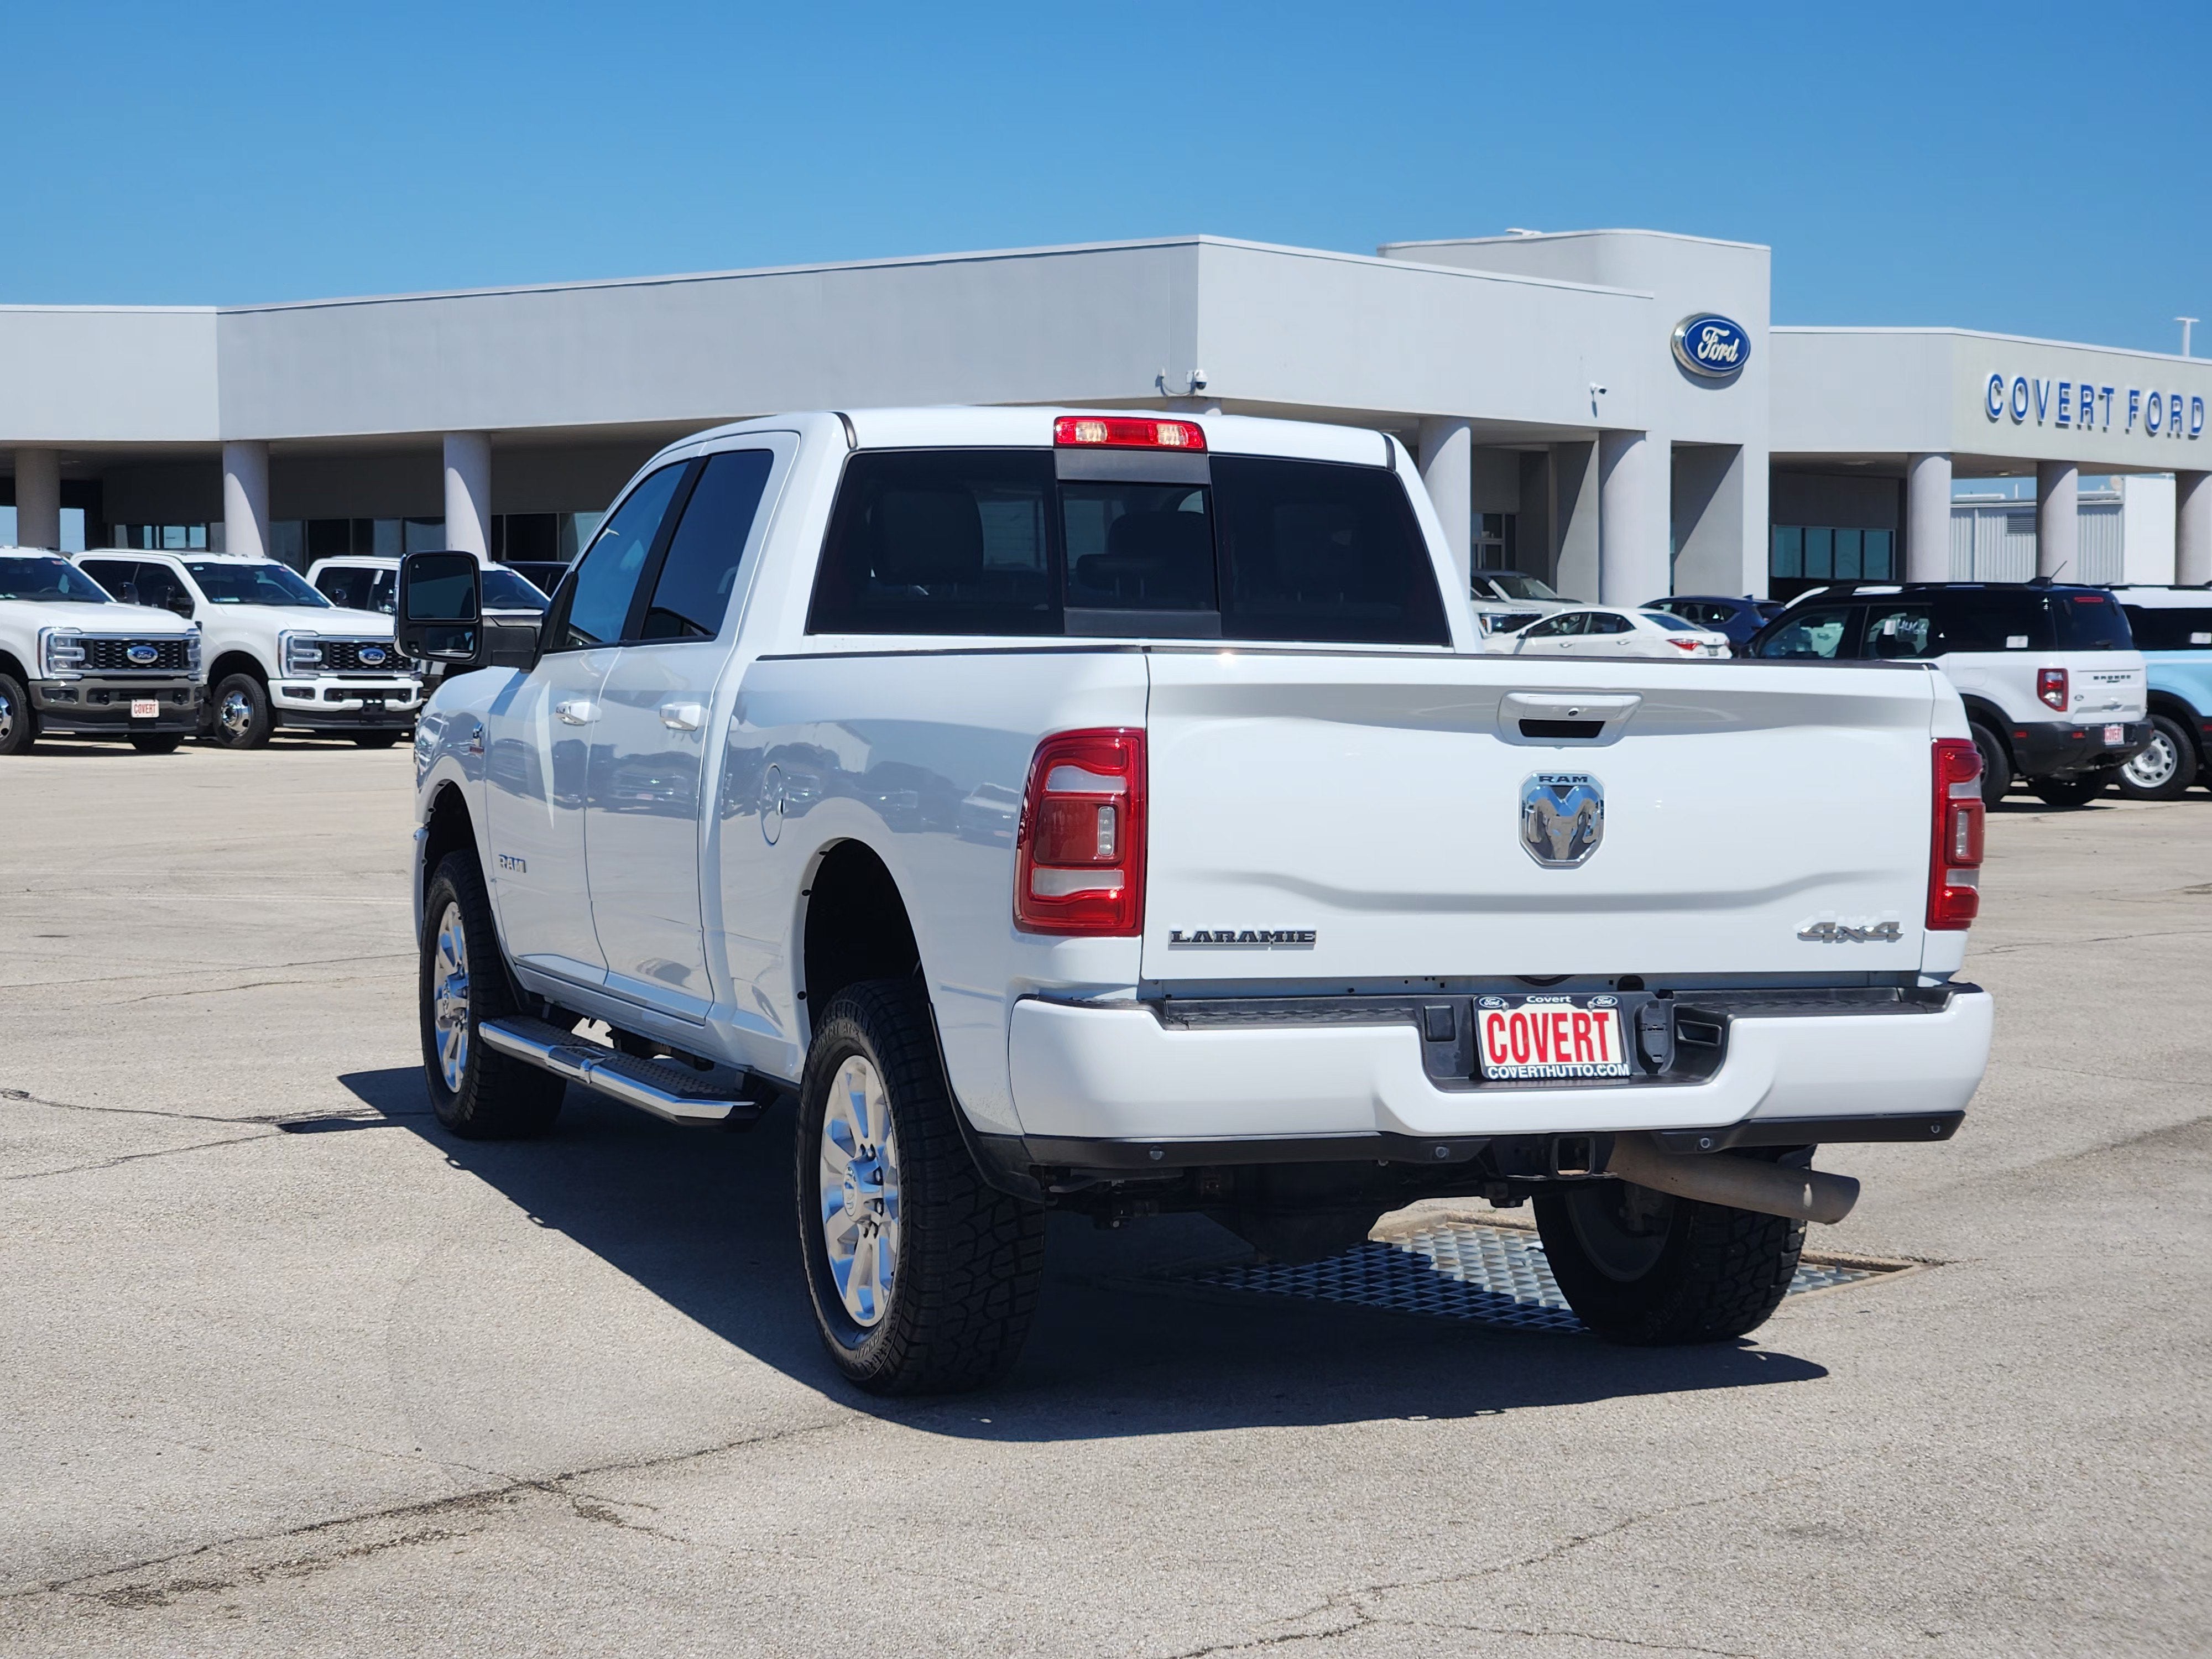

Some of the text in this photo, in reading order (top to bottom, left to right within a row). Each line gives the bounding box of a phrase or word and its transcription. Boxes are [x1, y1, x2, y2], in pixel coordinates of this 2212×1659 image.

[1698, 326, 1740, 362] Ford
[1986, 374, 2204, 434] COVERT FORD
[134, 704, 156, 714] COVERT
[499, 854, 526, 873] RAM
[1169, 930, 1316, 945] LARAMIE
[1526, 995, 1572, 1004] Covert
[1486, 1012, 1610, 1065] COVERT
[1488, 1063, 1630, 1079] COVERTHUTTO.COM
